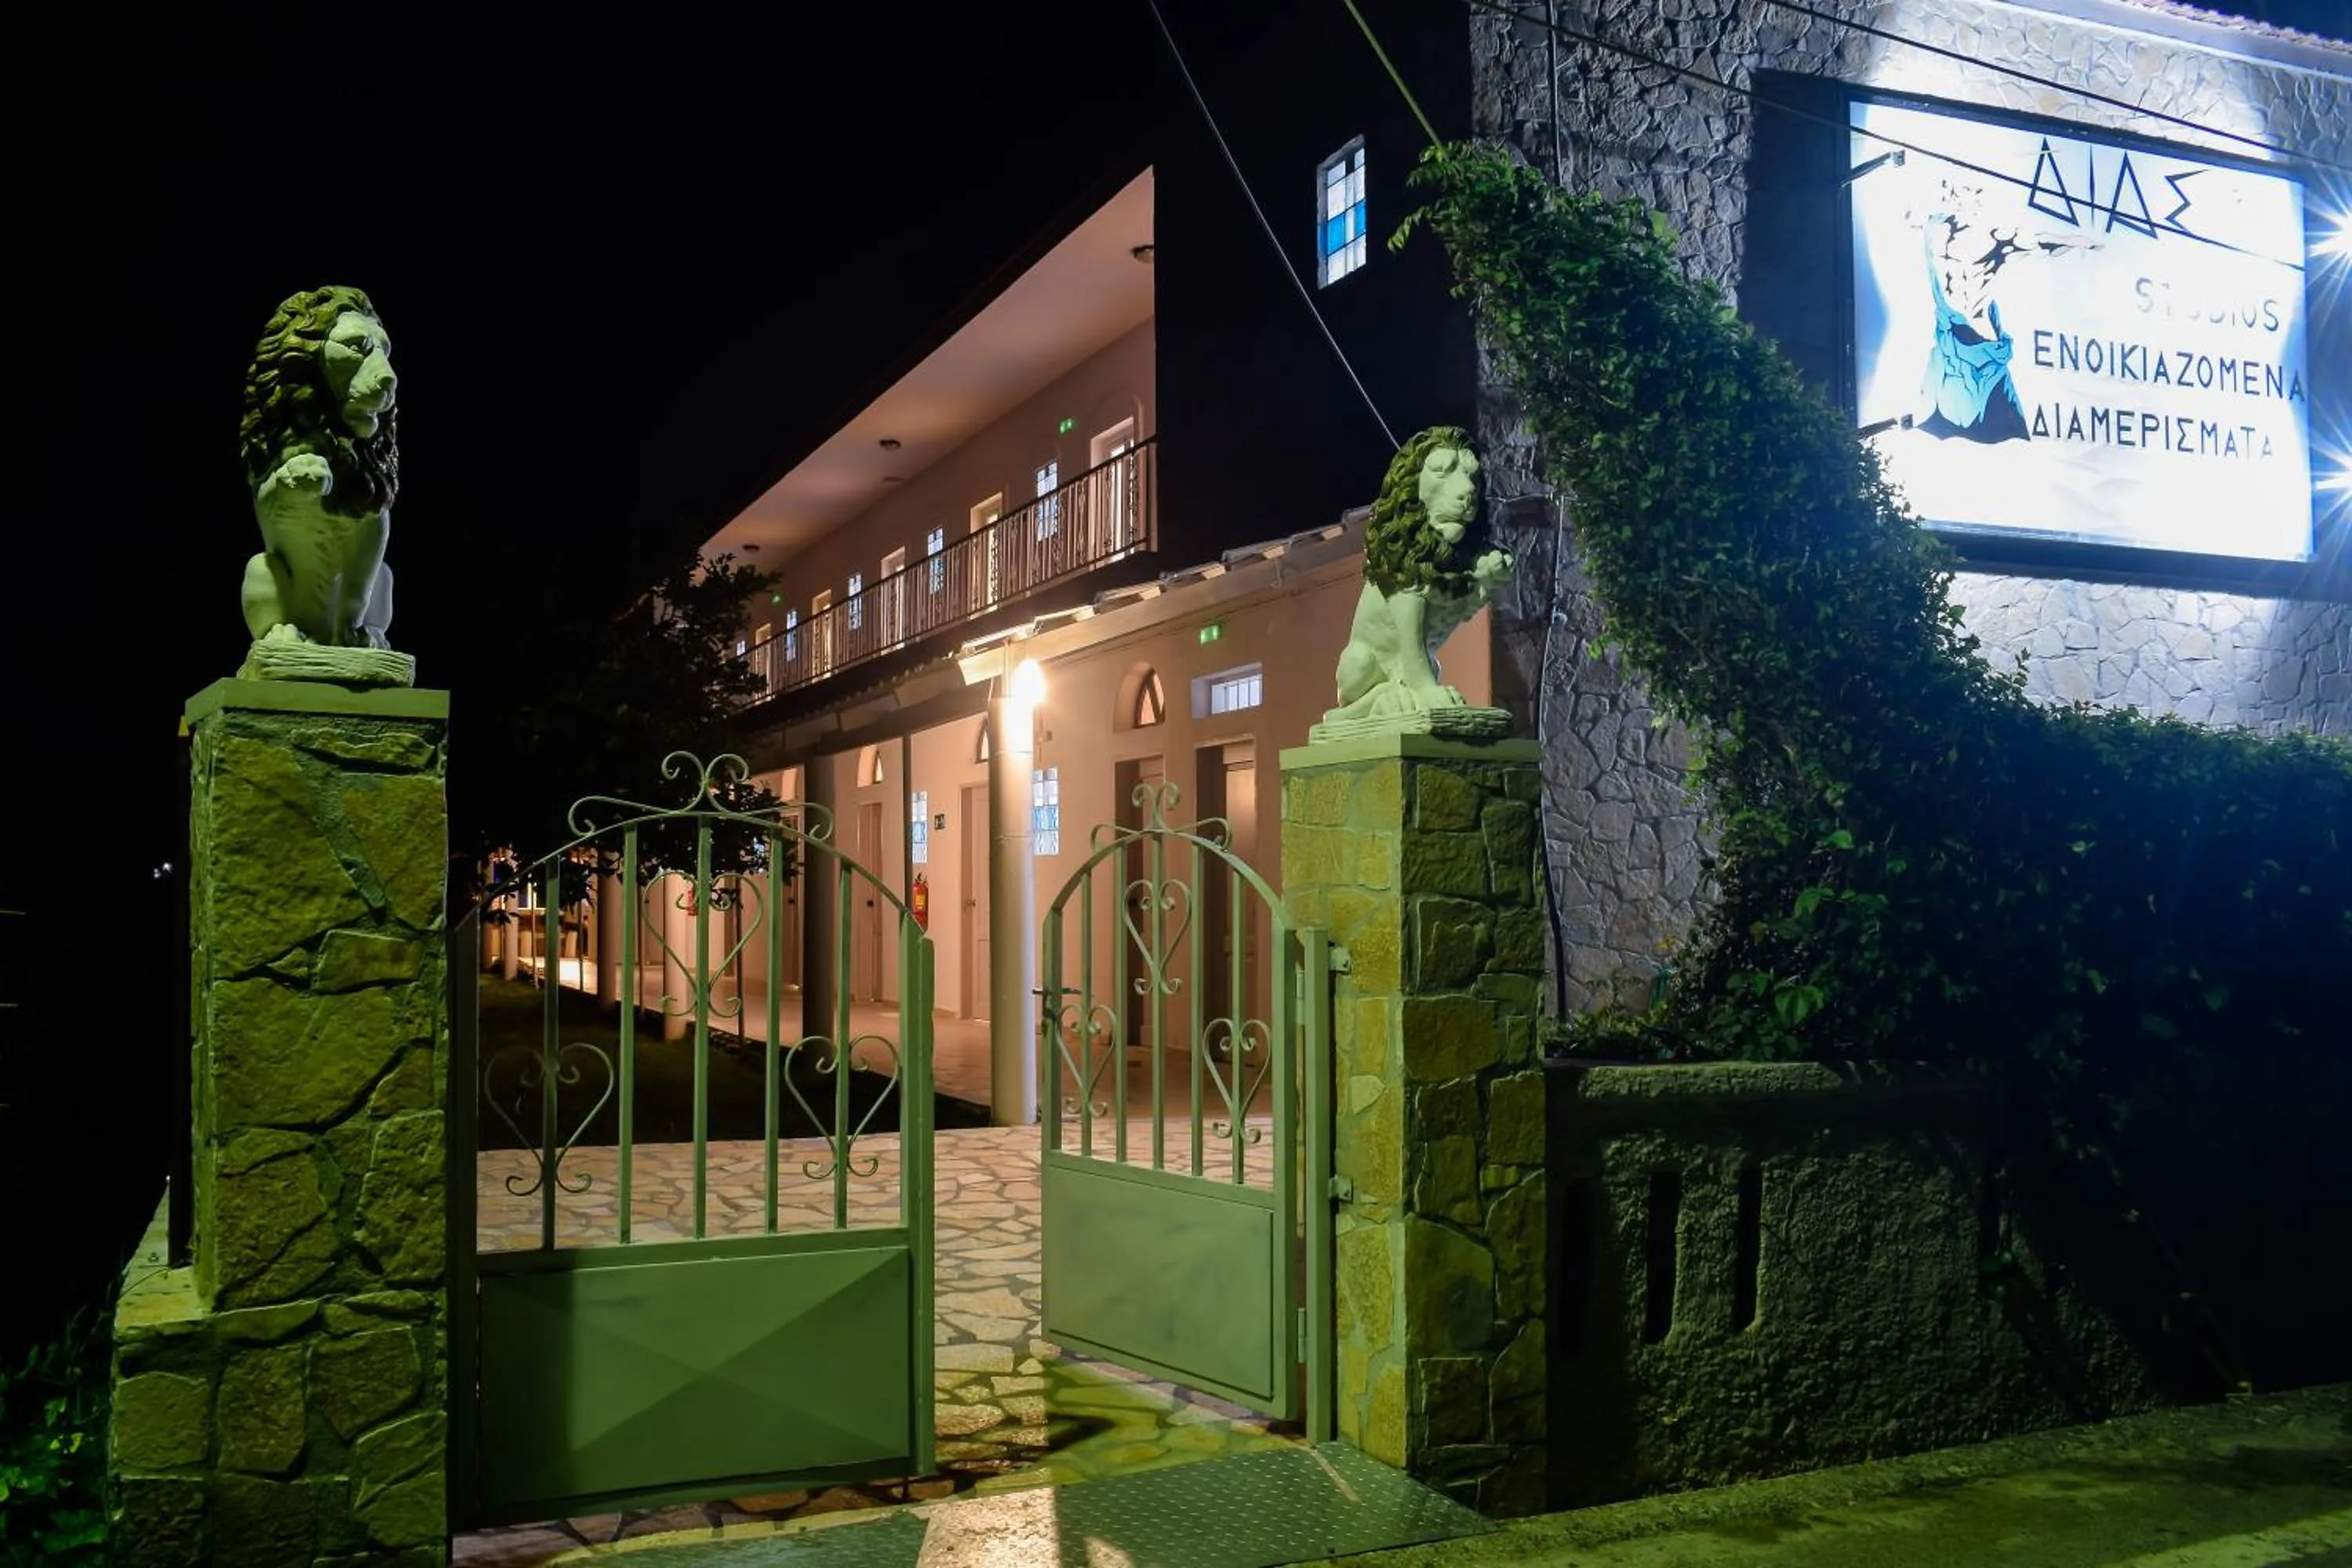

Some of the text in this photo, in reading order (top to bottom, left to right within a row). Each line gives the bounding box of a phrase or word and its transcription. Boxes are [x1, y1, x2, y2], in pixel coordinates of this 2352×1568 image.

[2028, 137, 2210, 238] ΔΙΑΣ
[2136, 278, 2279, 332] SIOS
[2034, 329, 2305, 401] ΕΝΟΙΚΙΑΖΟΜΕΝΑ
[2032, 402, 2273, 460] ΔΙΑΜΕΡΙΣΜΑΤΑ
